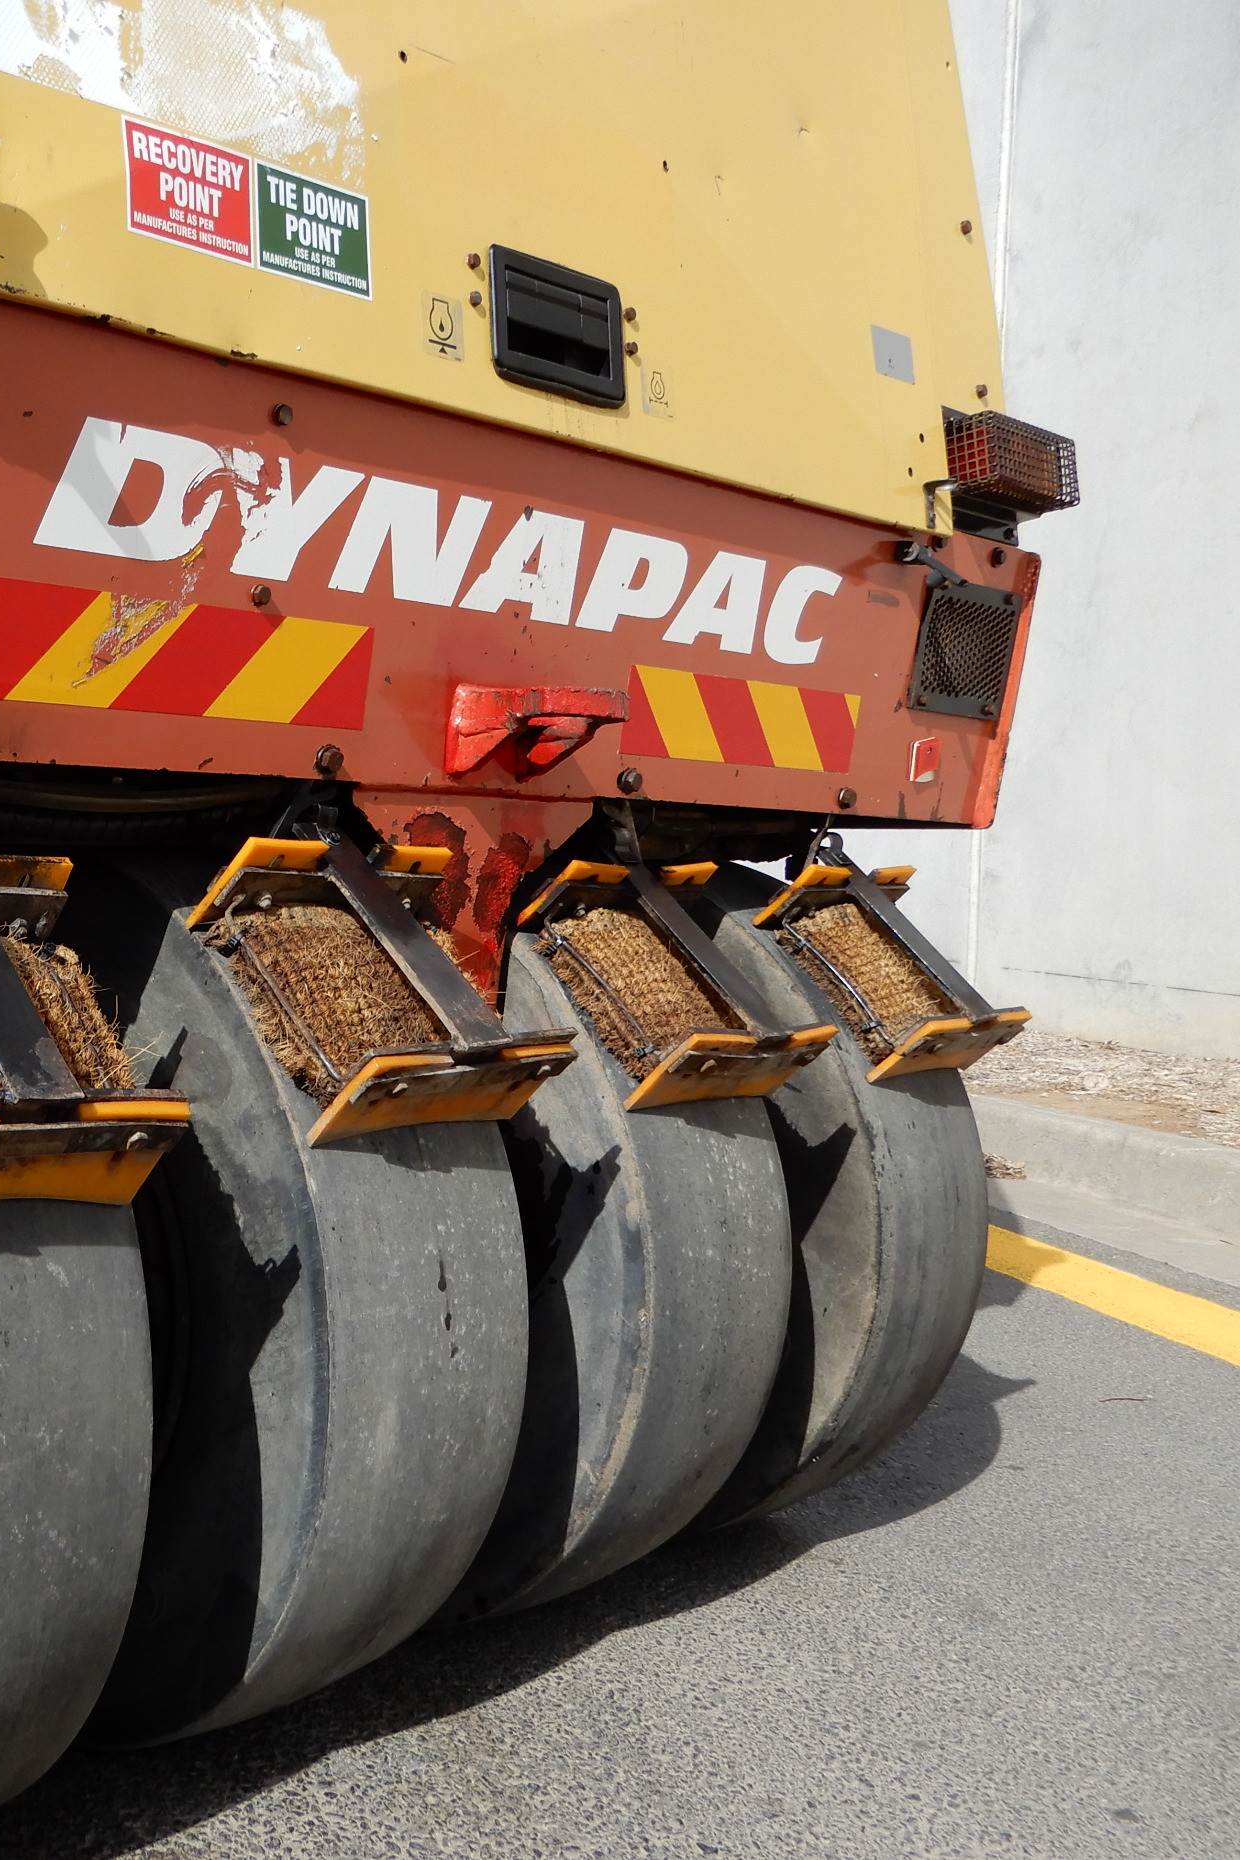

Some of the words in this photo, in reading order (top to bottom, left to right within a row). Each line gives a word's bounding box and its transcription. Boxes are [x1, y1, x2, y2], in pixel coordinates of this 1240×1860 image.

[132, 130, 243, 191] RECOVERY
[160, 172, 222, 217] POINT
[266, 175, 297, 210] TIE
[302, 187, 359, 231] DOWN
[134, 211, 197, 241] MANUFACTURES
[199, 232, 249, 256] INSTRUCTION
[169, 207, 185, 221] USE
[187, 212, 198, 225] AS
[199, 216, 214, 231] PER
[285, 214, 342, 255] POINT
[262, 251, 320, 277] MANUFACTURES
[322, 268, 367, 291] INSTRUCTION
[295, 246, 309, 261] USE
[310, 251, 320, 264] AS
[321, 254, 335, 268] PER
[33, 416, 843, 664] DYNAPAC
